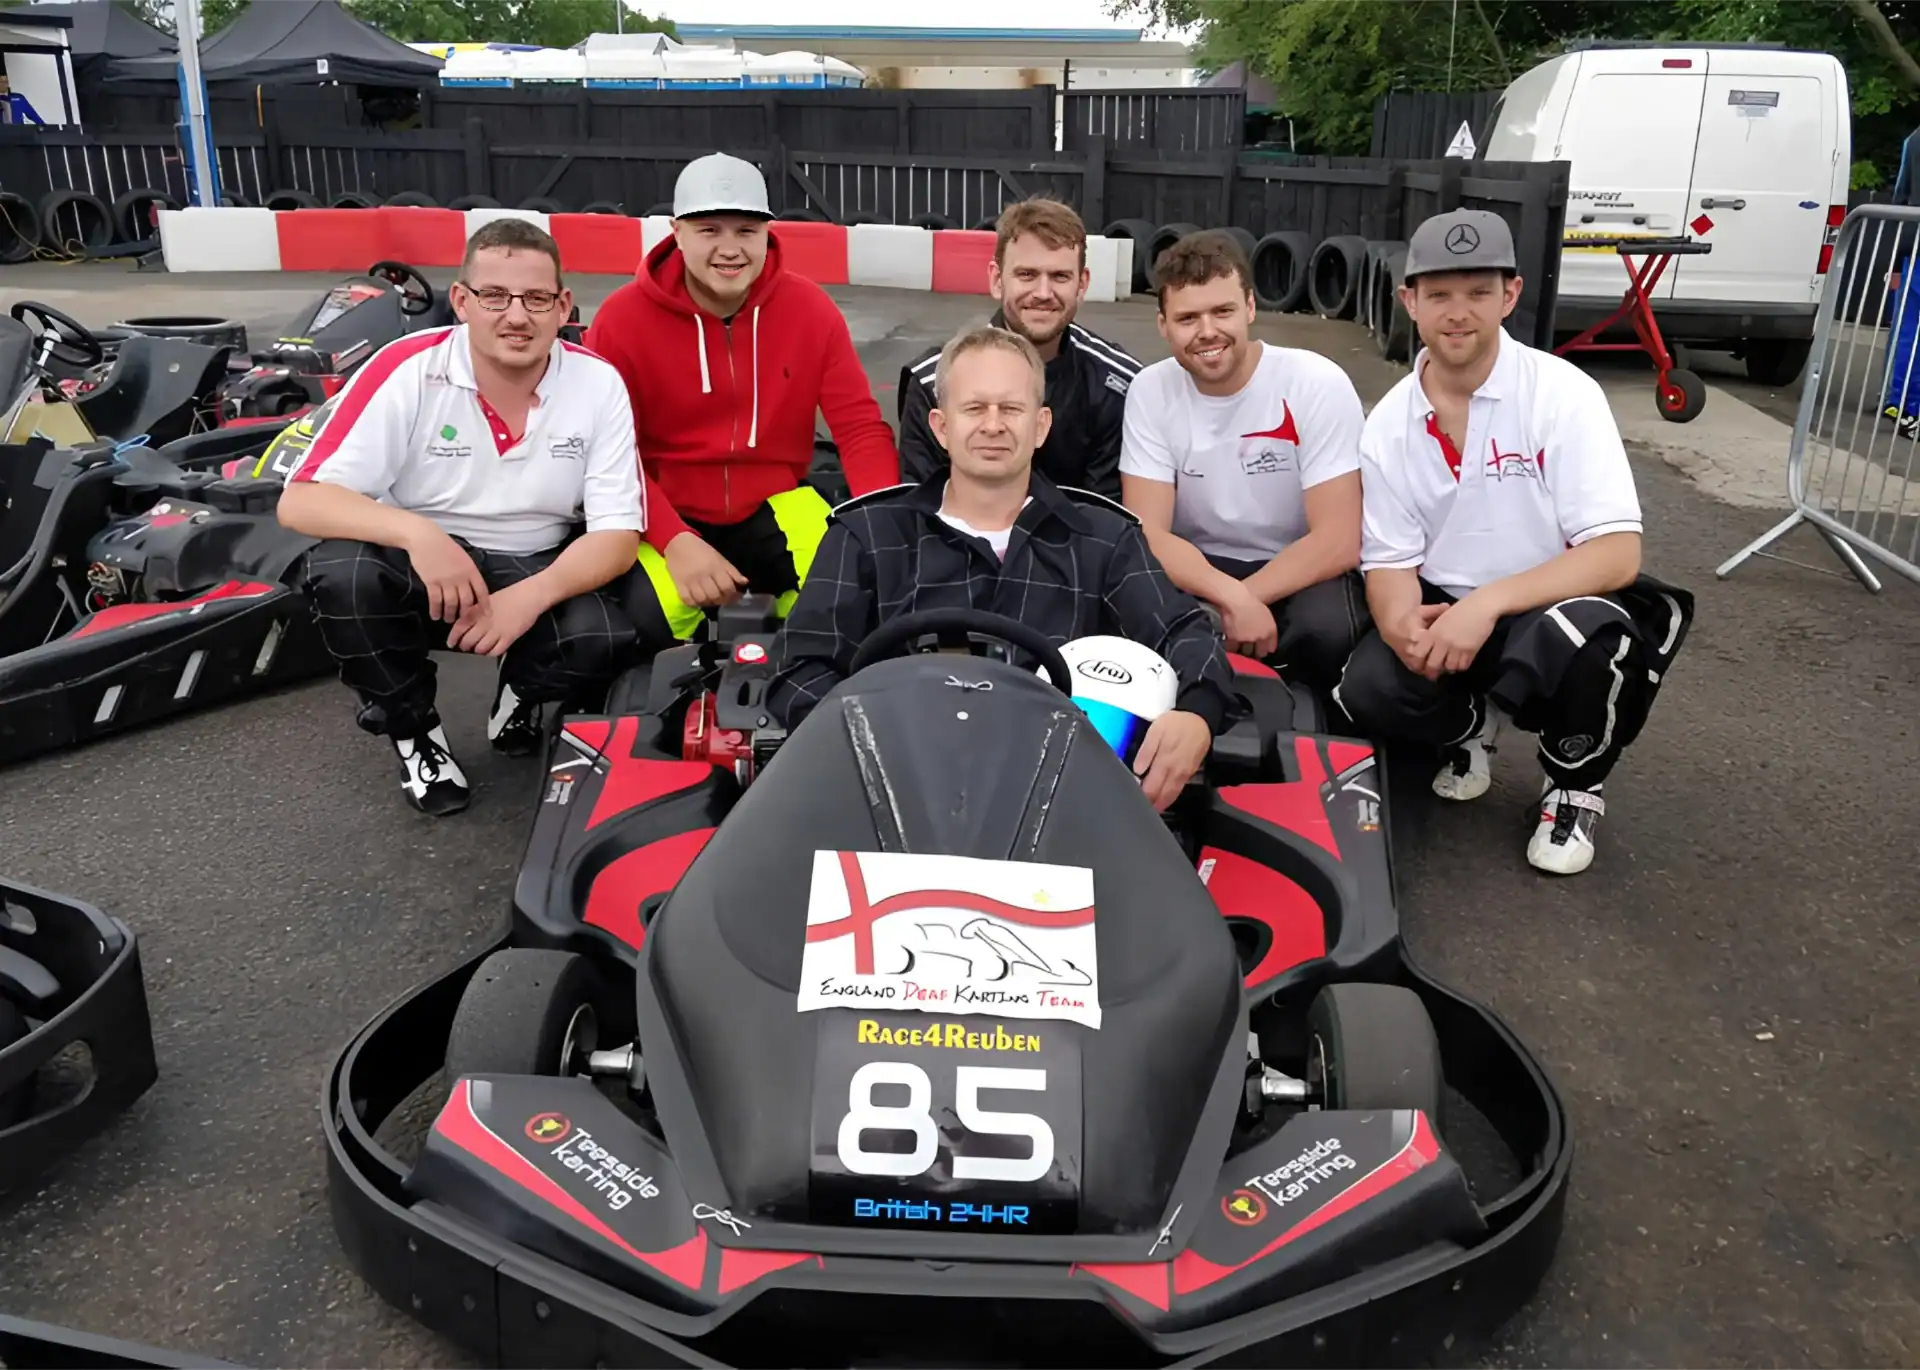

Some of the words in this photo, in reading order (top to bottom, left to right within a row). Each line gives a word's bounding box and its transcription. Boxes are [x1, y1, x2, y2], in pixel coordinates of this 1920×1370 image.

[837, 1060, 1055, 1183] 85
[564, 1127, 661, 1199] Teesside
[1244, 1137, 1342, 1193] Teesside
[854, 1198, 941, 1221] British
[949, 1202, 1030, 1225] 24HR
